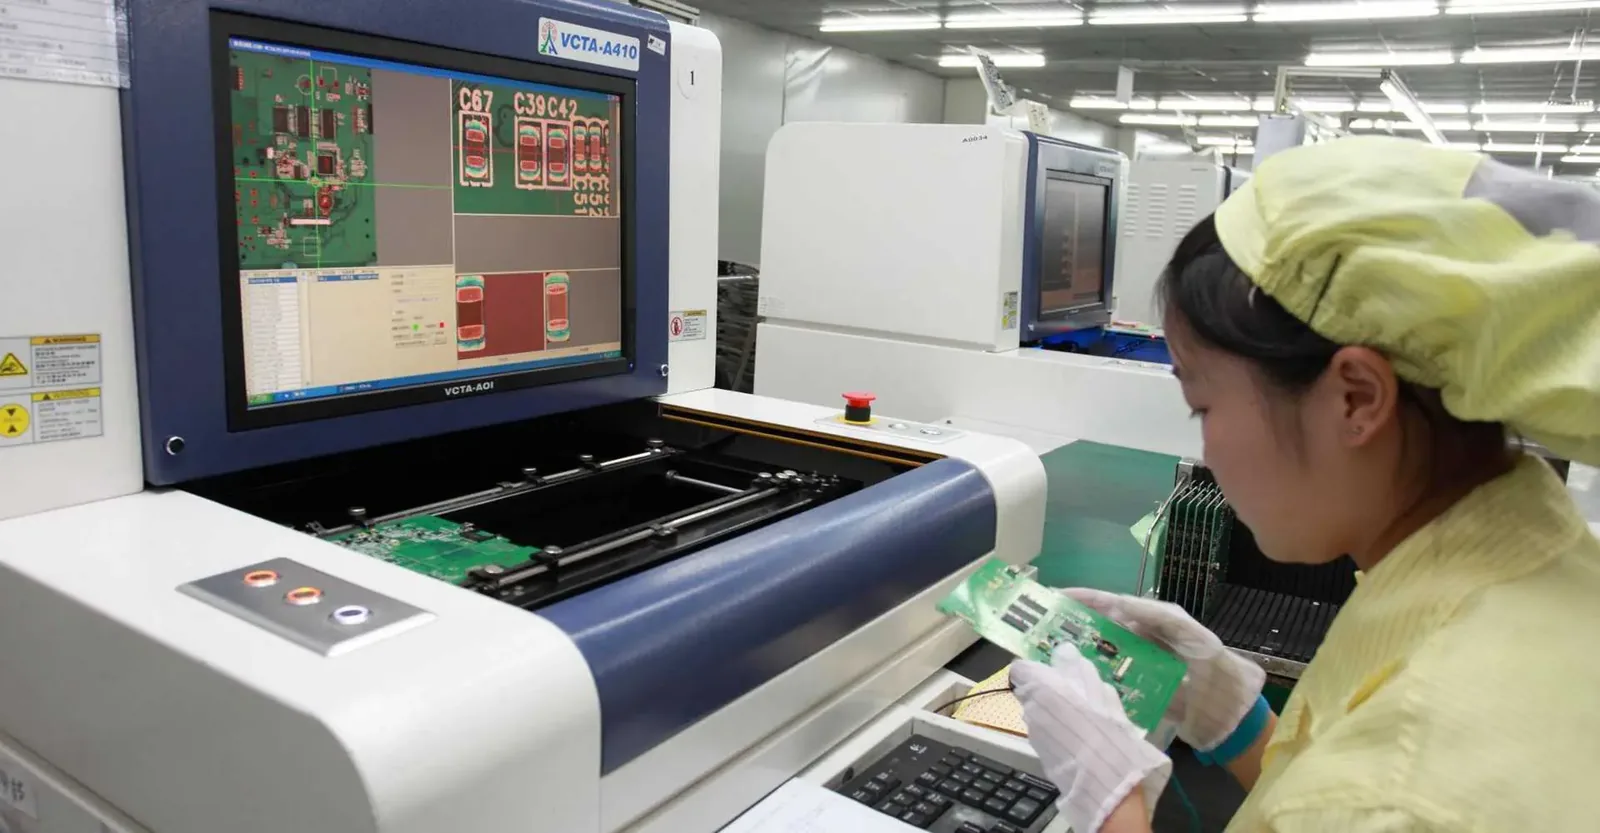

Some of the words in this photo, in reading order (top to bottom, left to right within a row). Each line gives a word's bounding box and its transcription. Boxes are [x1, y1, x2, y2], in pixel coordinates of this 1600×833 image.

[561, 32, 637, 60] VCTA-A410
[690, 71, 695, 86] 1
[460, 87, 494, 113] C67
[514, 92, 546, 116] C39
[548, 97, 577, 119] C42
[574, 178, 588, 214] C51
[444, 381, 494, 396] VCTA-AOI
